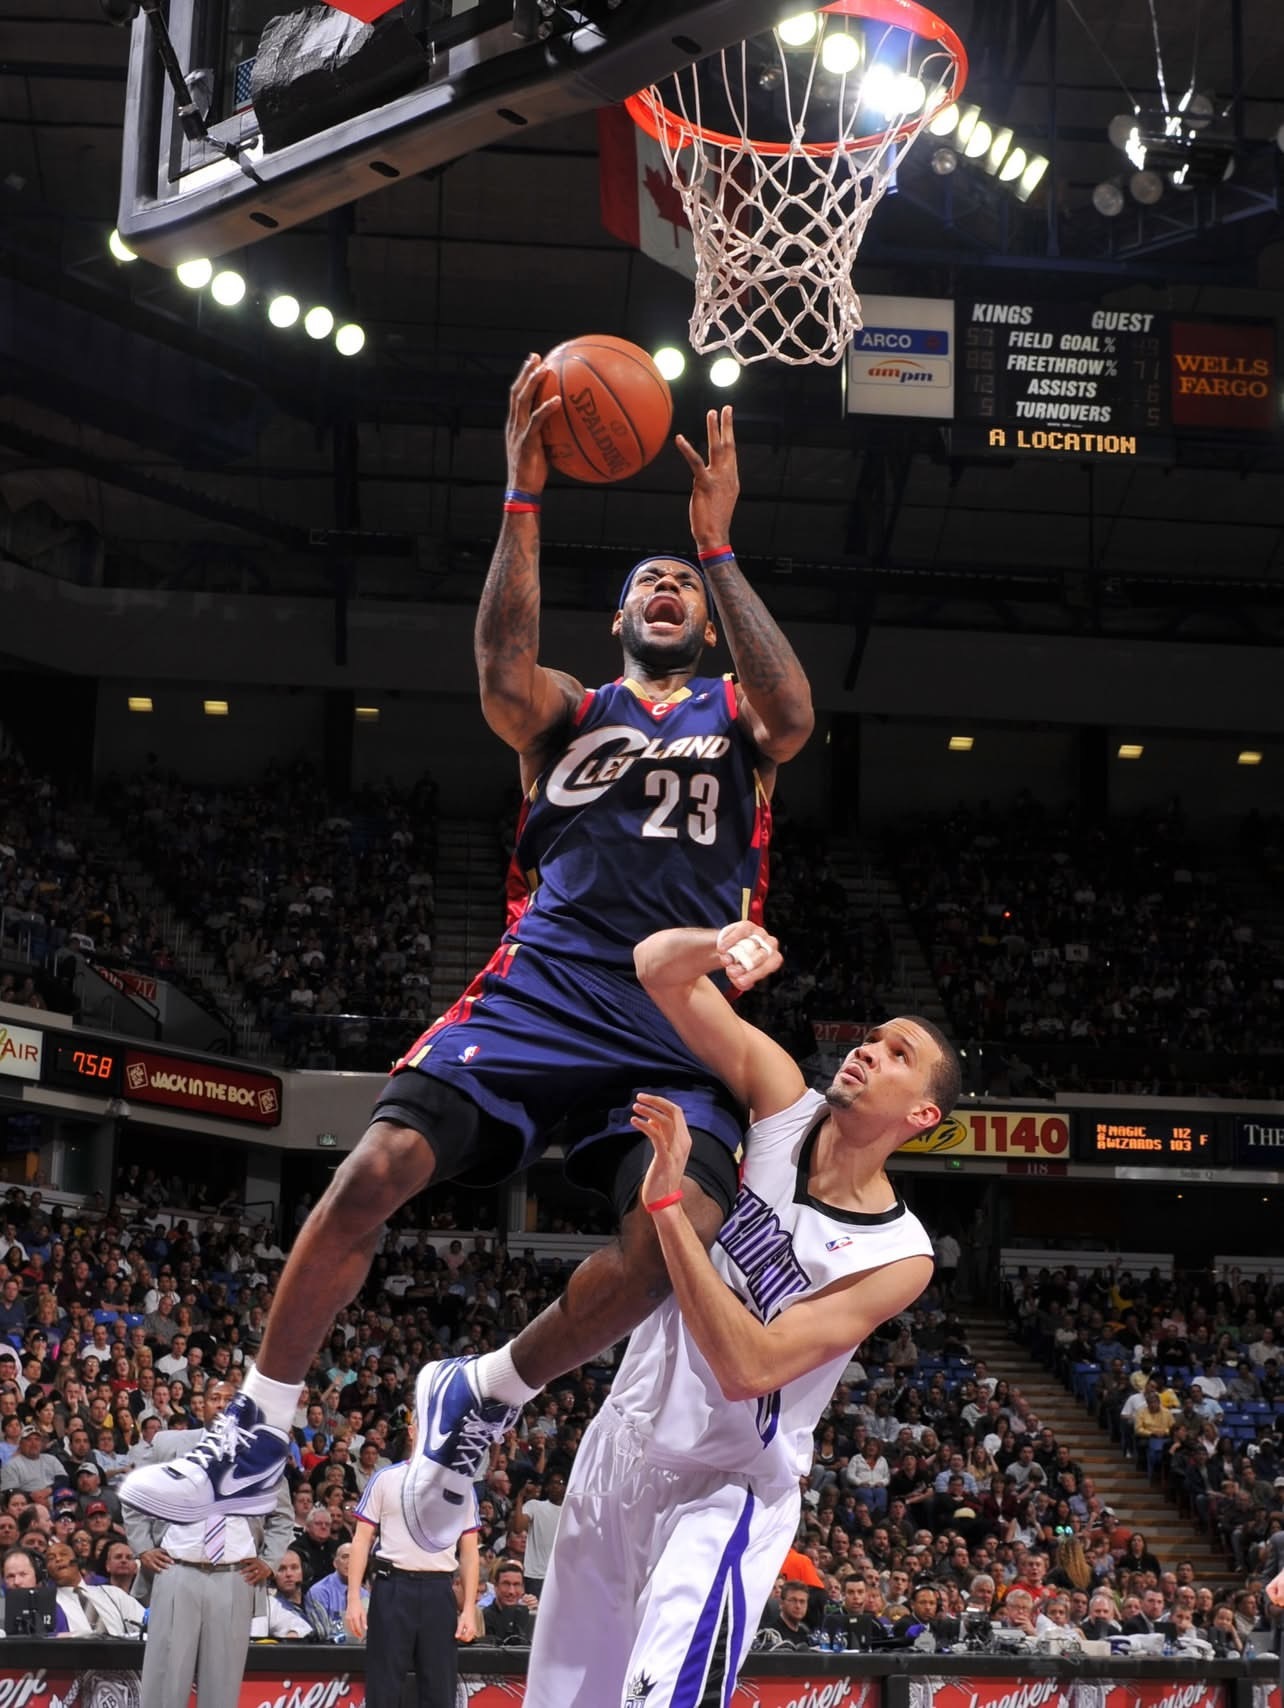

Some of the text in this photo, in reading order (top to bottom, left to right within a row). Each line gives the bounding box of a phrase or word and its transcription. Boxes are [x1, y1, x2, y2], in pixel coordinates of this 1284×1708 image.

[972, 304, 1033, 326] KINGS
[1092, 311, 1154, 333] GUEST
[861, 332, 912, 349] ARCO
[1008, 331, 1053, 349] FIELD
[868, 367, 933, 384] ampm
[1174, 354, 1269, 377] WELLS
[1027, 378, 1098, 398] ASSISTS
[1178, 376, 1269, 399] FARGO
[1016, 401, 1112, 424] TURNOVERS
[988, 428, 1136, 455] A LOCATION
[651, 703, 668, 715] C
[642, 770, 720, 845] 23
[1, 1038, 38, 1062] AIR
[151, 1071, 187, 1093] JACK
[188, 1077, 203, 1096] IN
[205, 1081, 227, 1101] THE
[228, 1086, 256, 1107] BOX
[970, 1115, 1068, 1155] 1140
[1108, 1125, 1192, 1139] MAGIC 112
[1199, 1134, 1208, 1146] F
[1106, 1137, 1192, 1152] WIZARDS 103
[1026, 1161, 1048, 1176] 118
